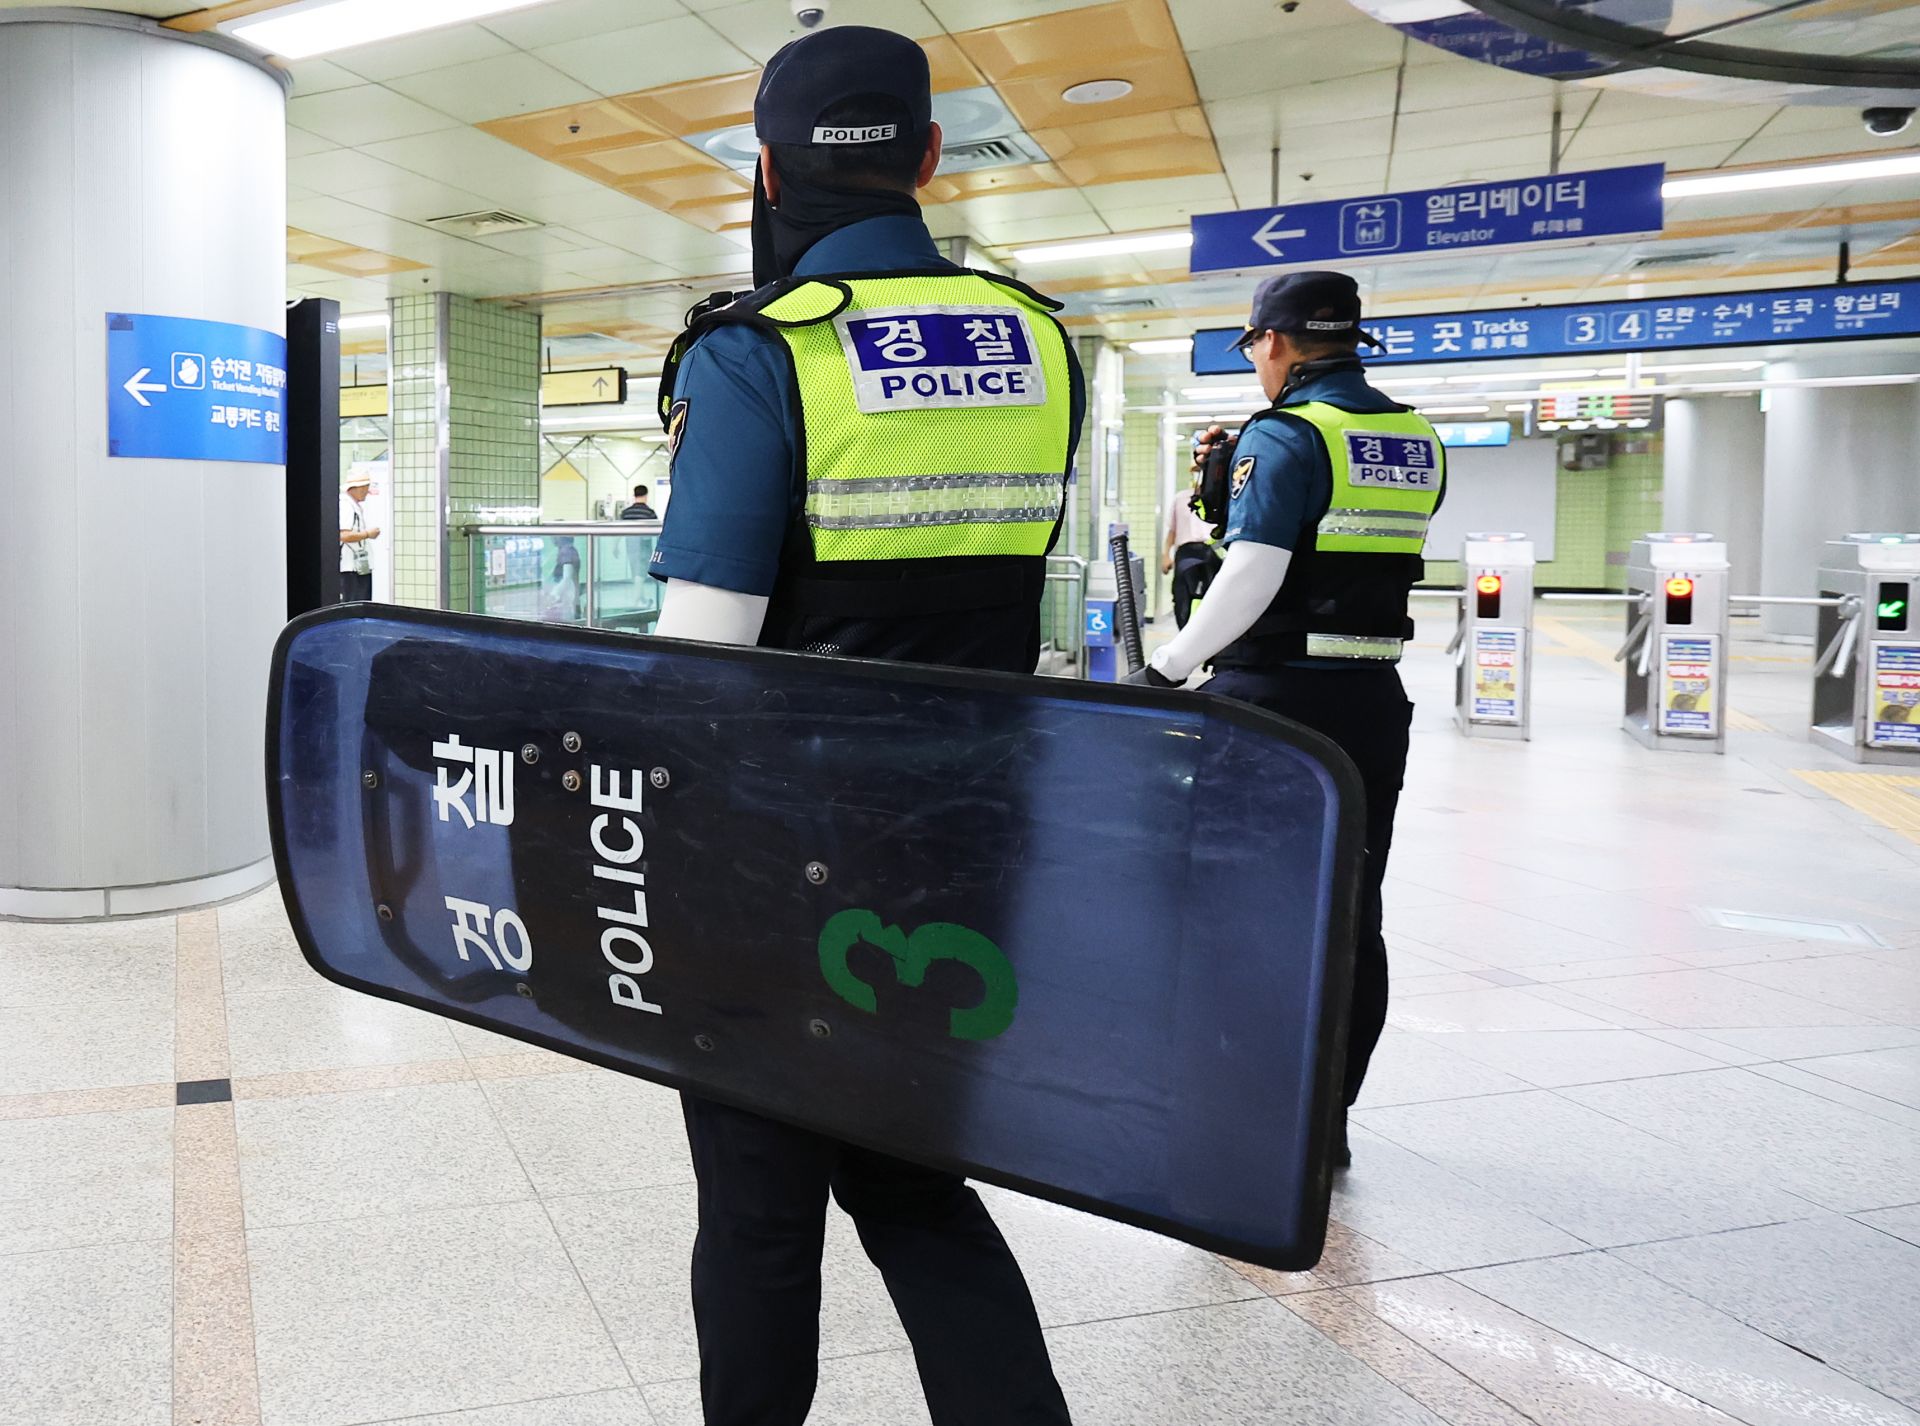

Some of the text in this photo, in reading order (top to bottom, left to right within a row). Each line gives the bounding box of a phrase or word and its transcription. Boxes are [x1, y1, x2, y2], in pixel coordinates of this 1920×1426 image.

[823, 126, 893, 141] POLICE
[1426, 179, 1587, 225] 엘리베이터
[1426, 227, 1495, 246] Elevator
[1712, 302, 1755, 321] 수서
[1772, 298, 1815, 316] 도곡
[1834, 292, 1902, 313] 왕십리
[1432, 322, 1463, 353] 곳
[1471, 318, 1530, 335] Tracks
[1575, 316, 1597, 343] 3
[1617, 313, 1642, 341] 4
[210, 356, 252, 382] 승차권
[880, 371, 1026, 399] POLICE
[210, 405, 281, 433] 교통카드 충전
[590, 763, 663, 1015] POLICE
